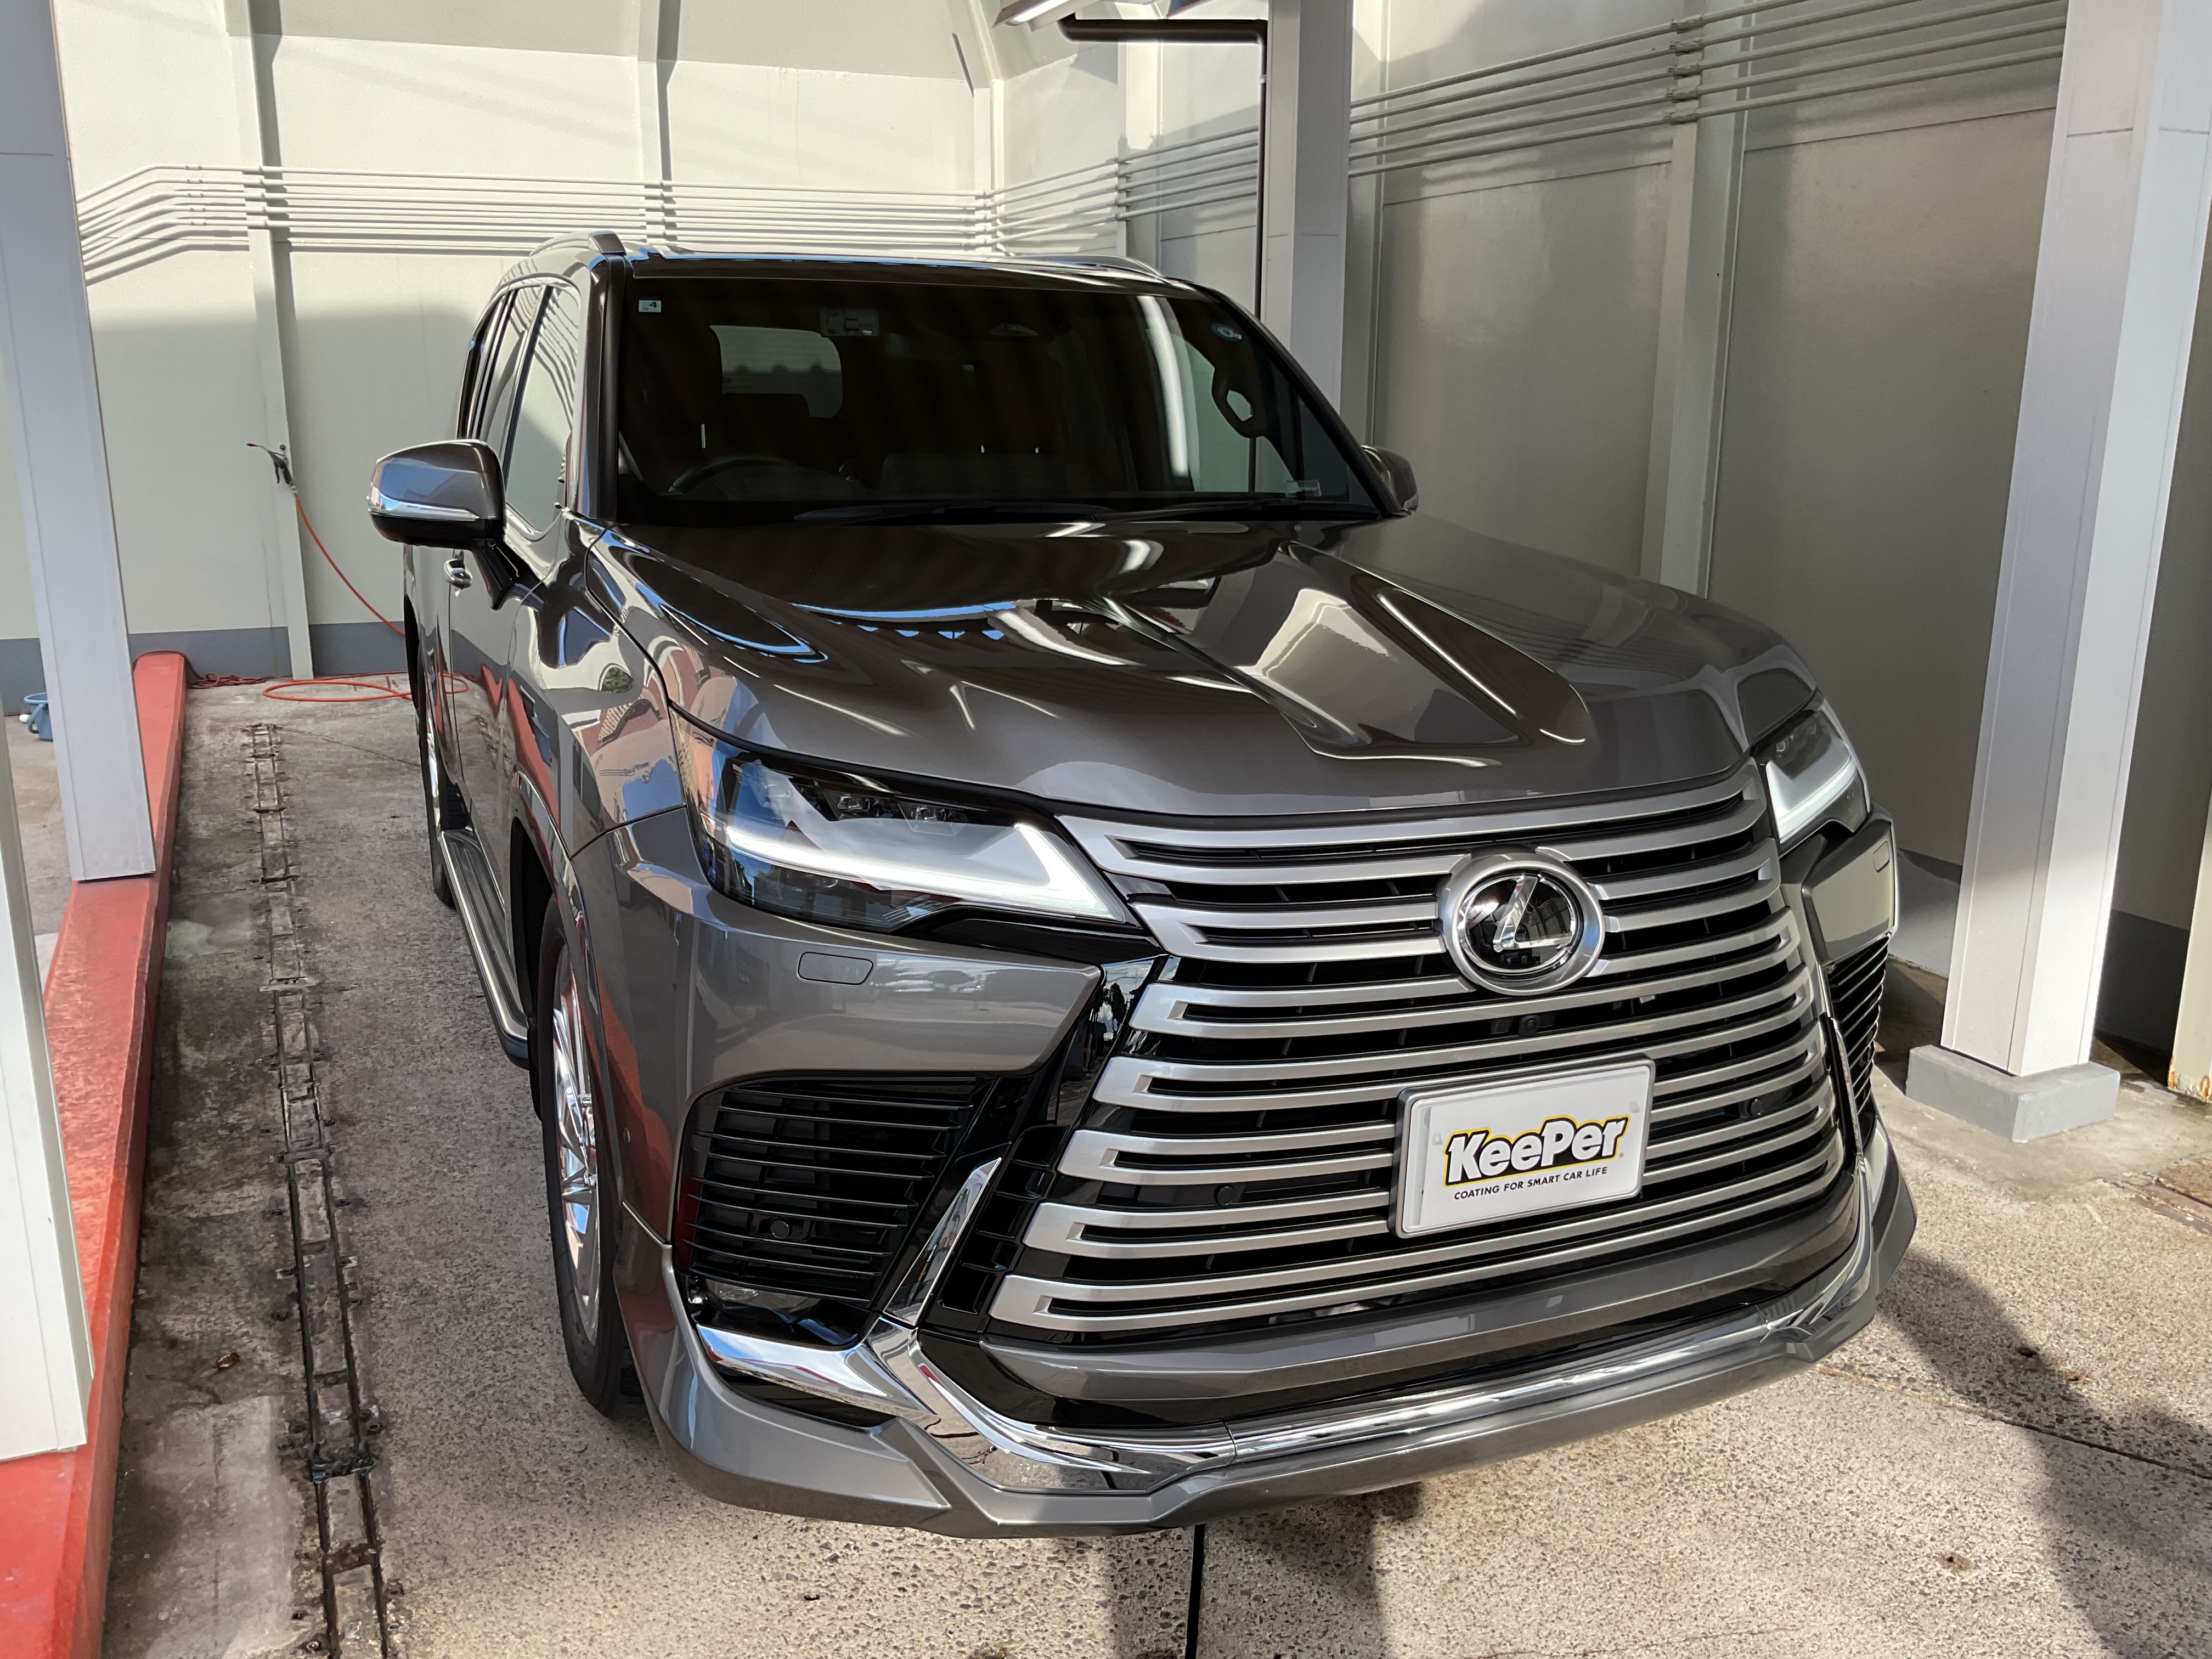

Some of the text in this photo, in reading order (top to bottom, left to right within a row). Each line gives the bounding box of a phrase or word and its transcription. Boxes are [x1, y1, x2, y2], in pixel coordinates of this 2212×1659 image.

[1445, 1117, 1628, 1186] KeePer
[1454, 1166, 1608, 1200] COATING FOR SMART CAR LIFE
